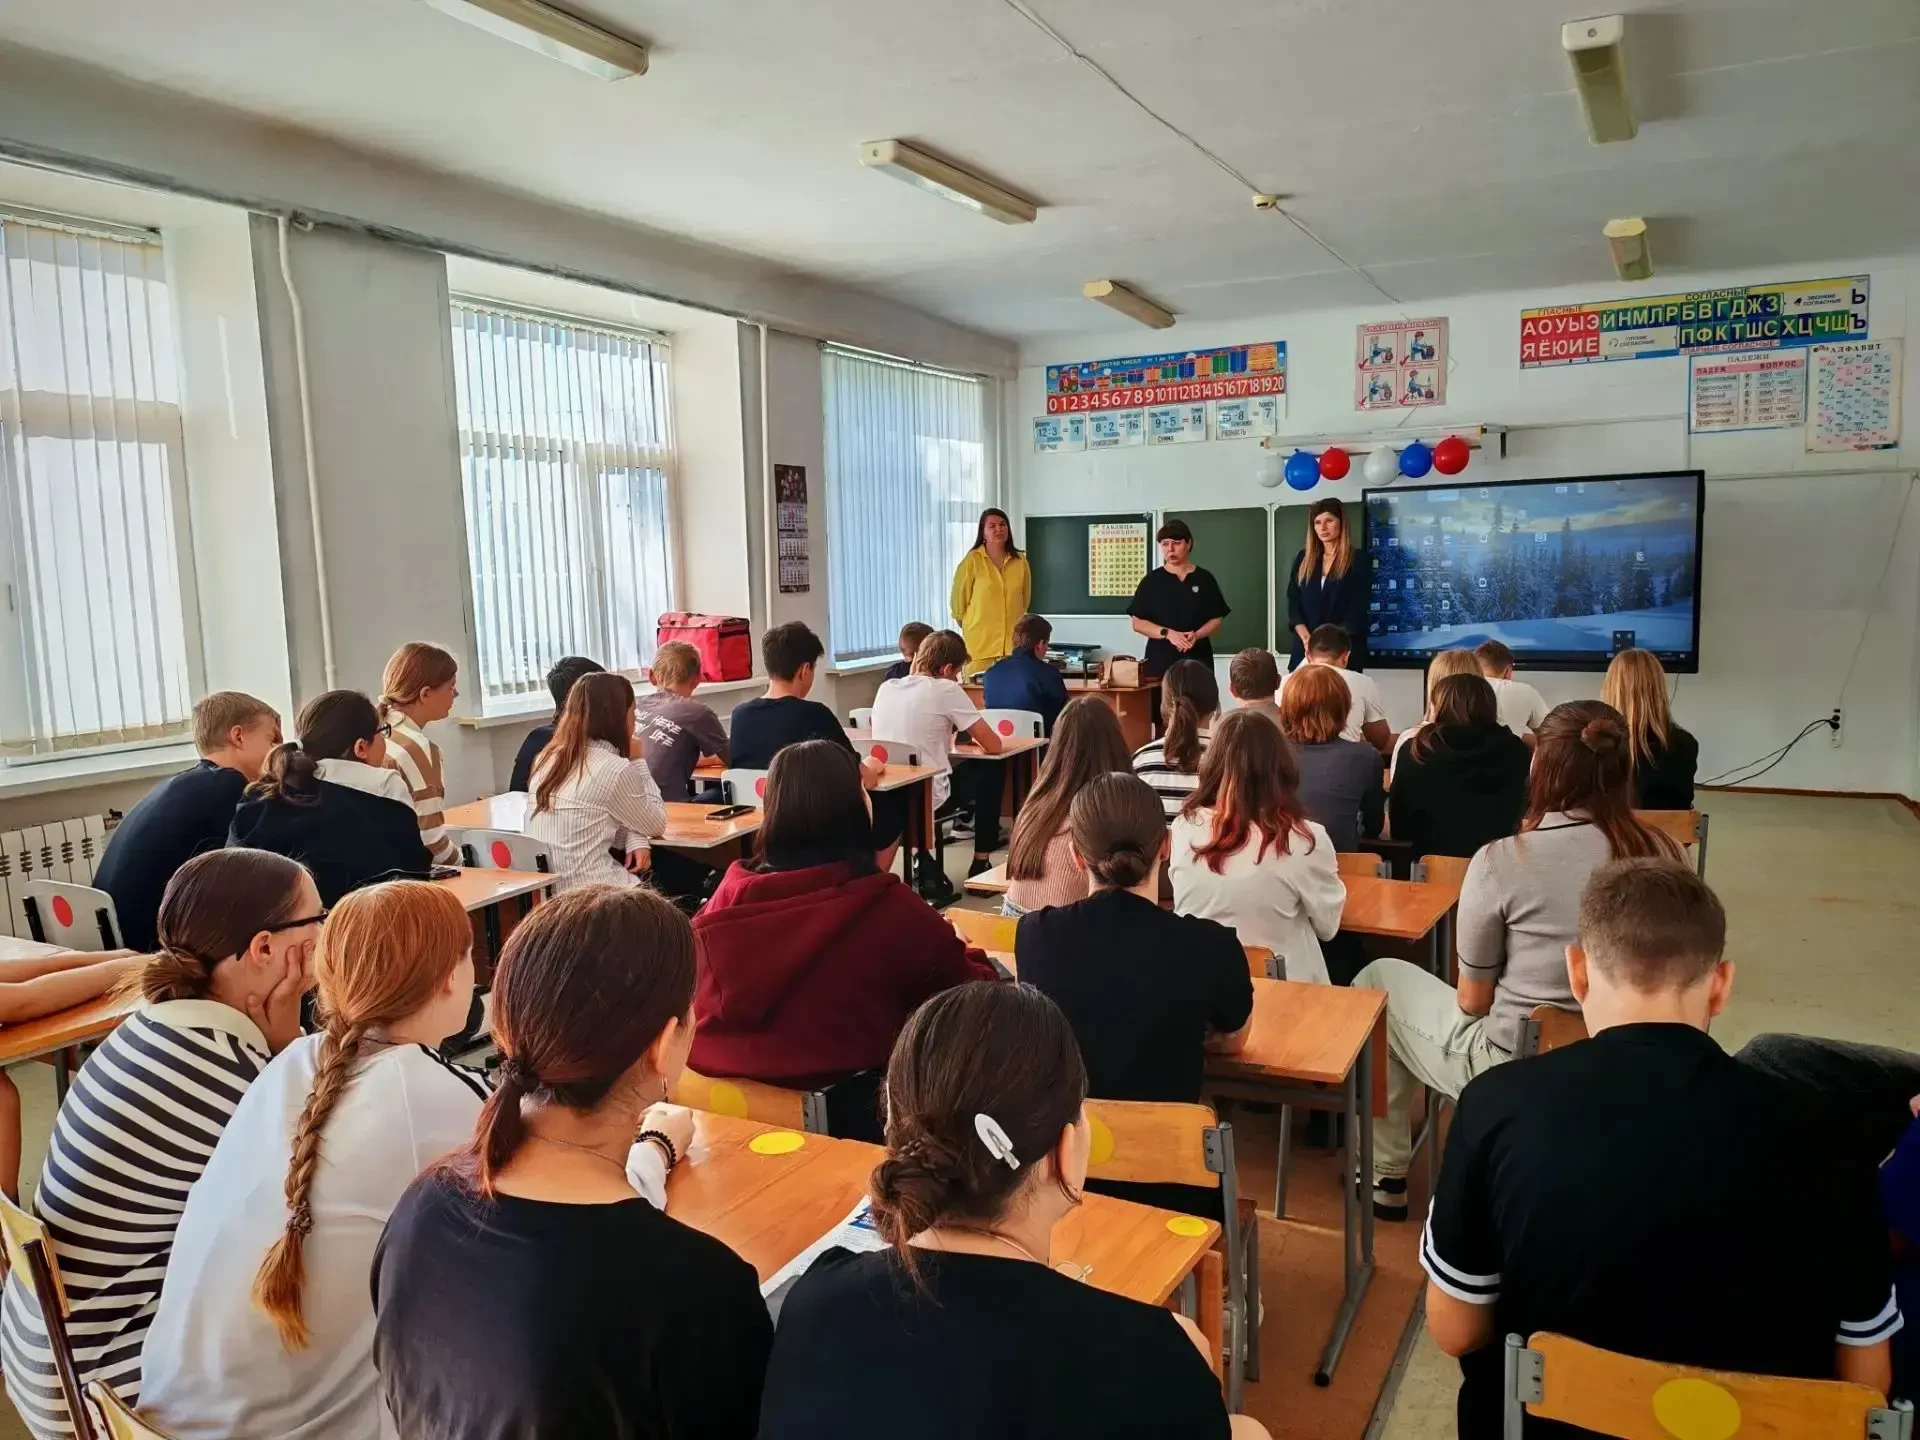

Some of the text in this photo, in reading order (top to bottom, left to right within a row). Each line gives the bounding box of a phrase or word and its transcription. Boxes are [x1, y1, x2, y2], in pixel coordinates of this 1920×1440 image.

[1685, 288, 1750, 300] СОГЛАСНЫЕ
[1538, 305, 1584, 316] ГЛАСНЫЕ
[1830, 343, 1881, 353] АЛФАВИТ
[1728, 353, 1769, 363] ПАДЕЖИ
[1696, 360, 1797, 374] ПАДЕЖ ВОПРОС
[1049, 376, 1284, 411] 0 1 2 3 4 5 6 7 8 9 10 11 12 13 14 15 16 17 18 19 20
[1128, 420, 1139, 430] 16
[1192, 415, 1202, 425] 14
[1074, 426, 1080, 435] 4
